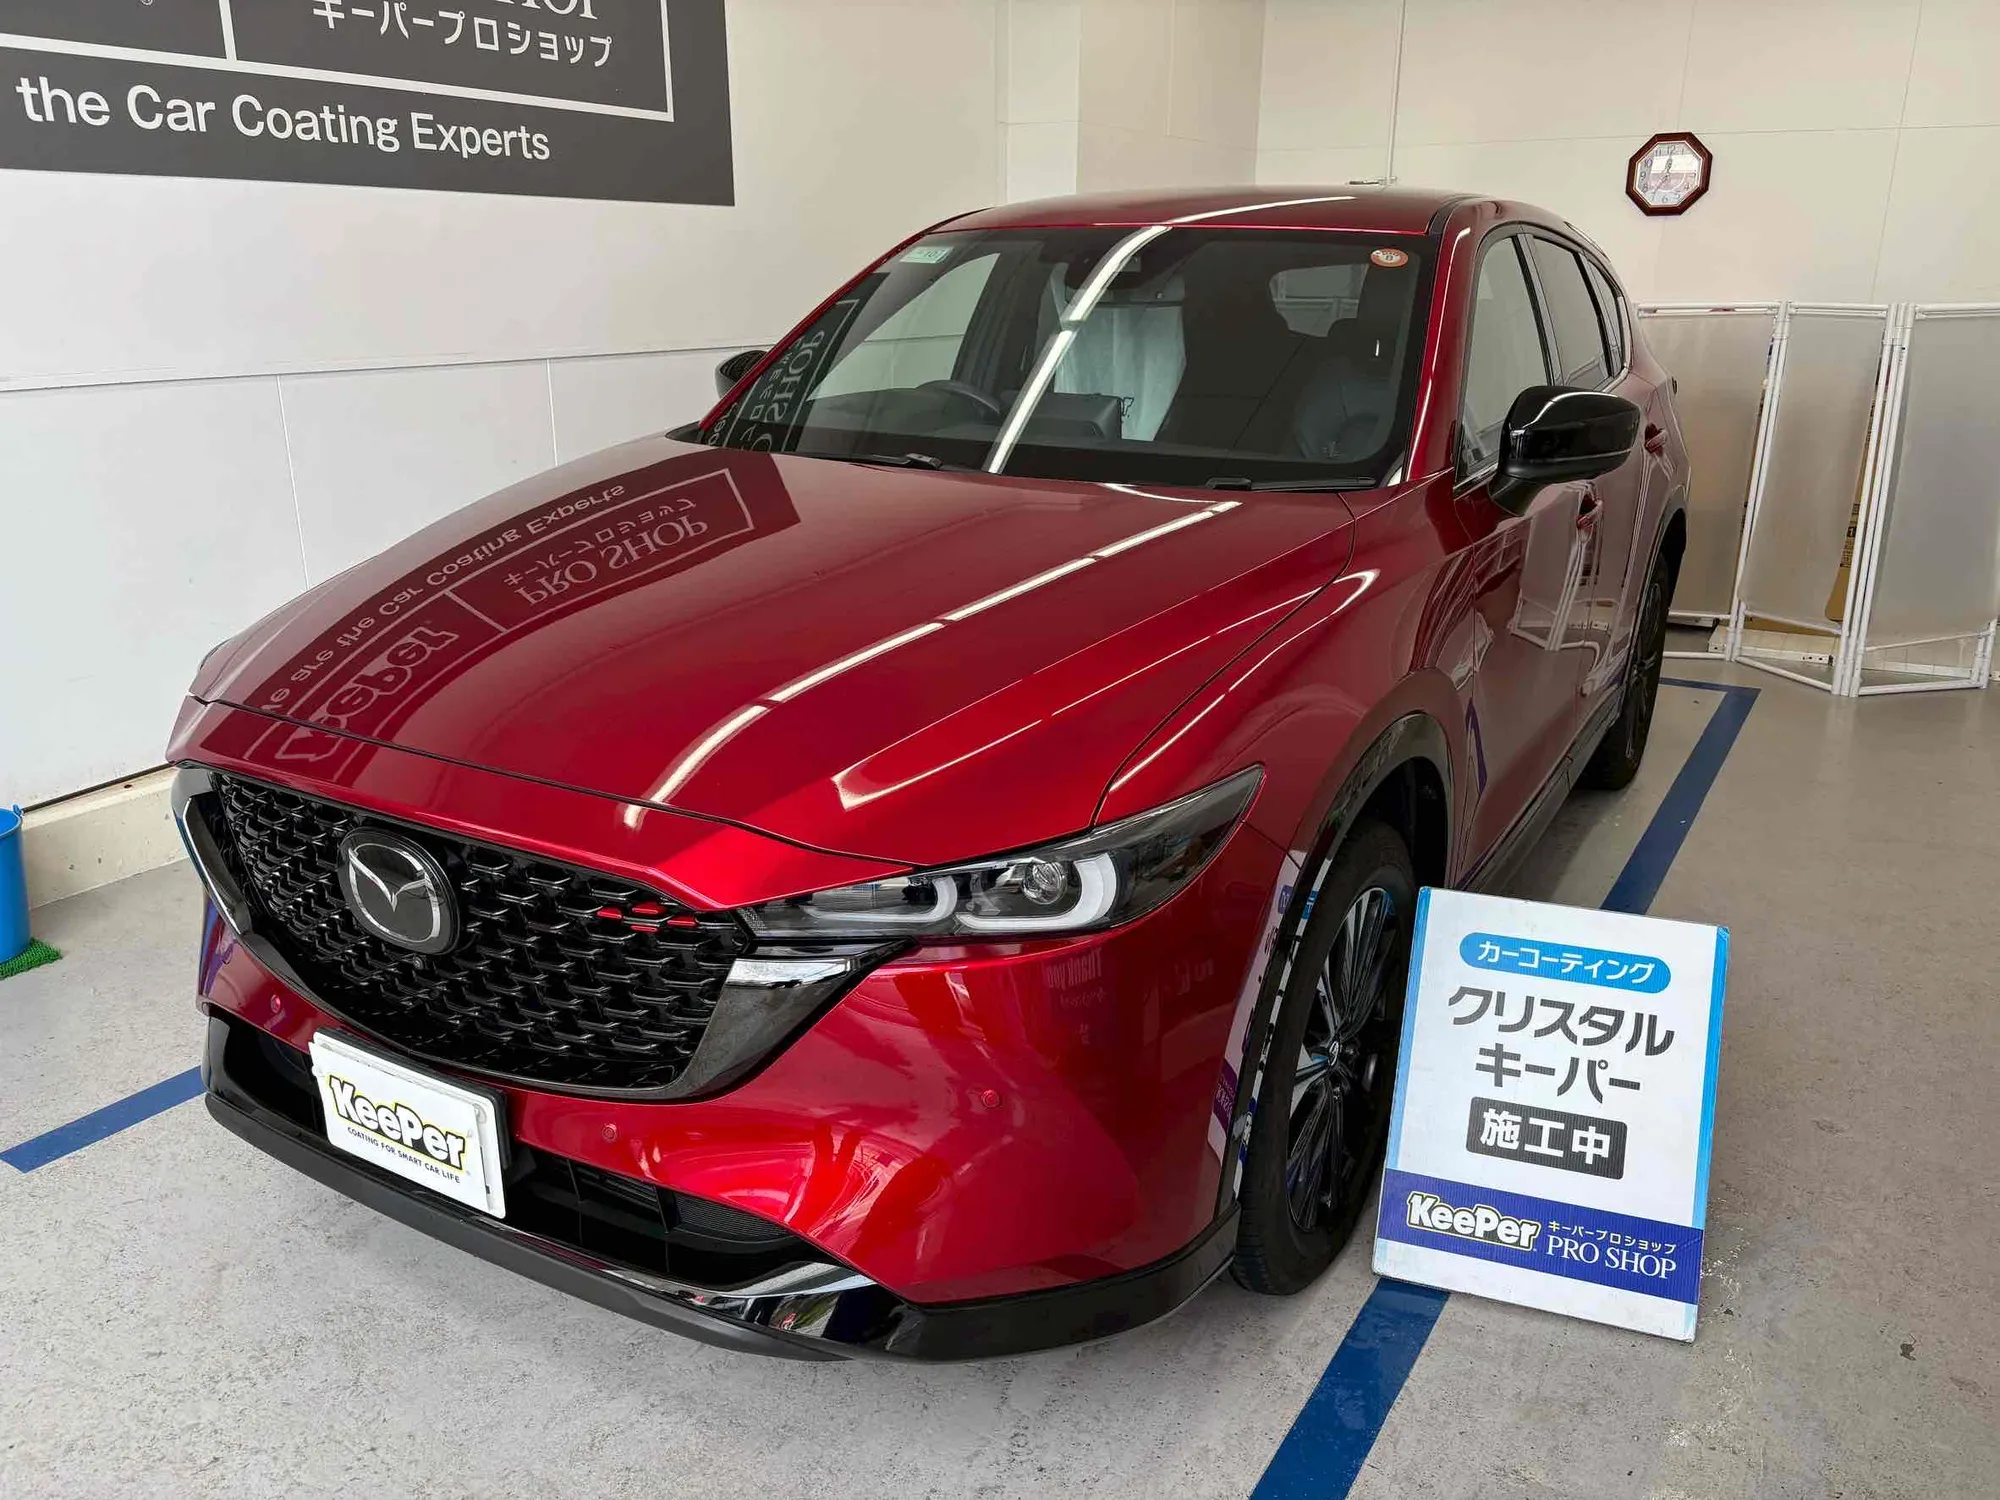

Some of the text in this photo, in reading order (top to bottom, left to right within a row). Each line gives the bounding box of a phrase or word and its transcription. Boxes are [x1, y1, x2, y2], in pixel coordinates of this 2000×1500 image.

[313, 0, 613, 67] キーパープロショップ
[15, 76, 550, 161] the Car Coating Experts
[1477, 940, 1655, 984] カーコーティング
[1448, 985, 1676, 1057] クリスタル
[1475, 1042, 1641, 1104] キーパー
[329, 1074, 466, 1171] KeePer
[1480, 1109, 1611, 1165] 施工中
[347, 1126, 460, 1184] COATING FOR SMART CAR LIFE
[1408, 1192, 1540, 1250] KeePer
[1548, 1220, 1677, 1254] キーパープロショップ
[1546, 1234, 1677, 1280] PRO SHOP
